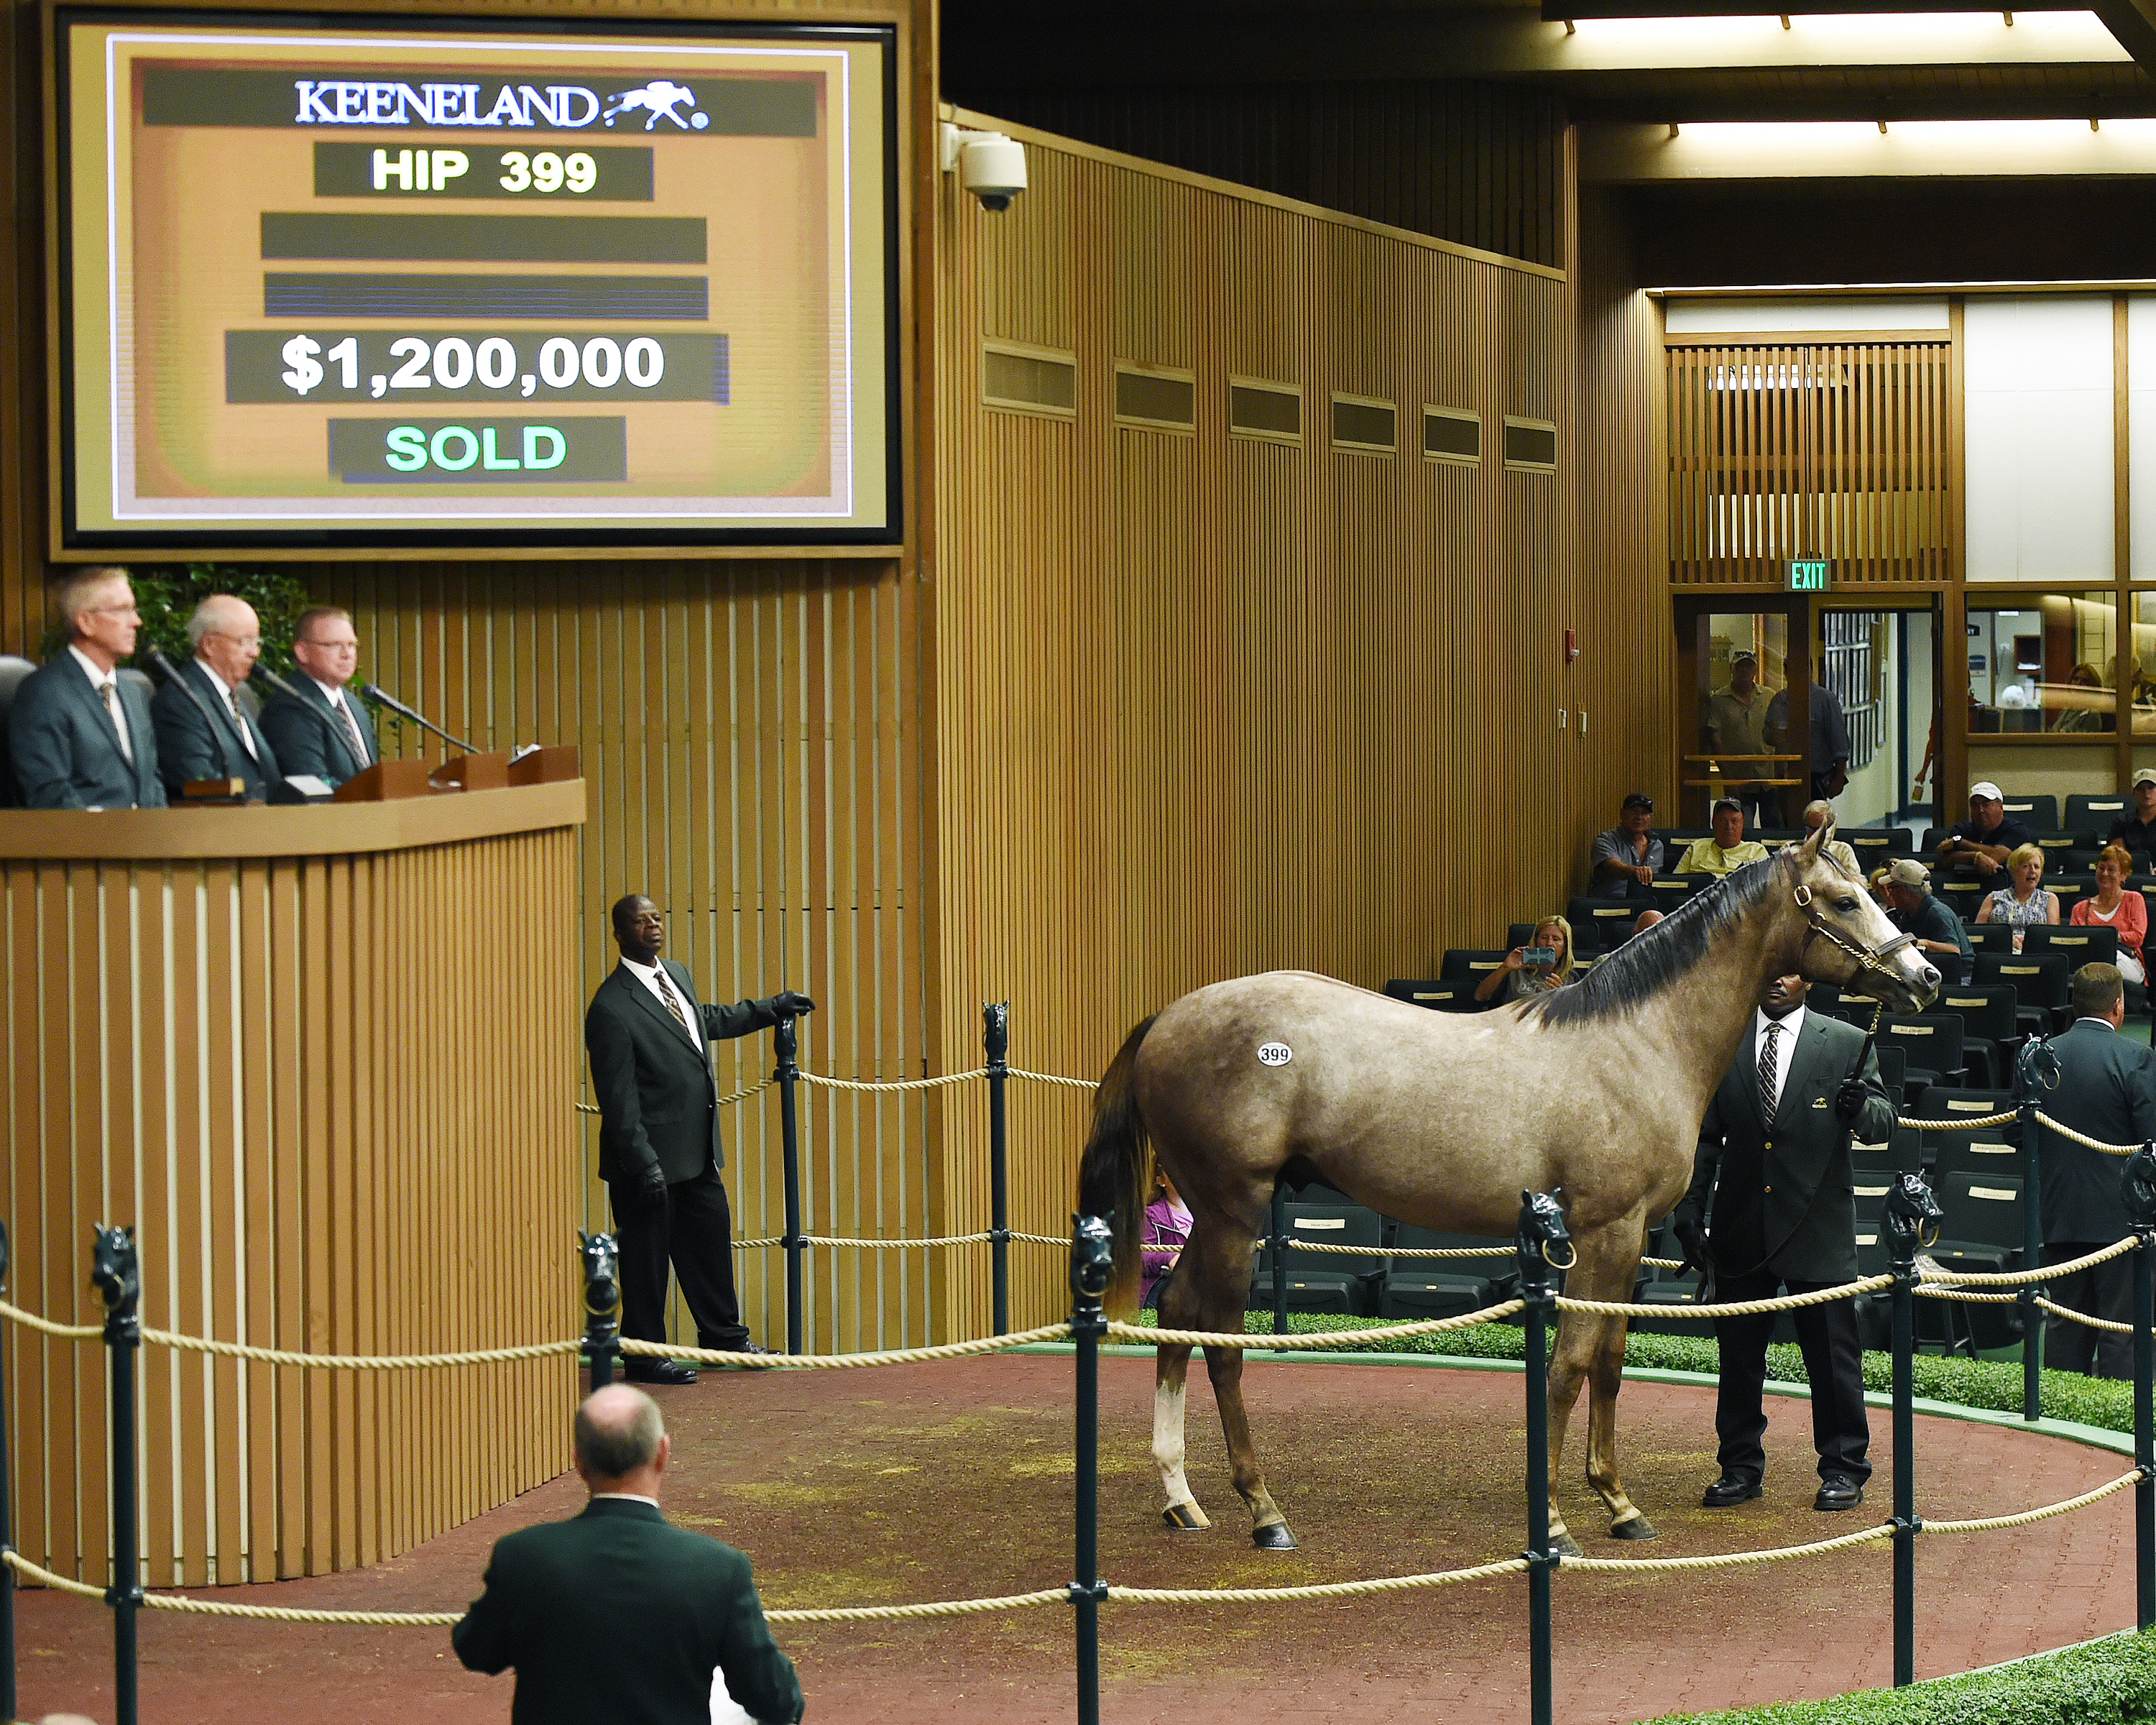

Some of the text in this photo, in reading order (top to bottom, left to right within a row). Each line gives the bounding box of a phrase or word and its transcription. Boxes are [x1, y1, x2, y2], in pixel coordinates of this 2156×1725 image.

[295, 80, 600, 127] KEENELAND
[372, 148, 598, 193] HIP 399
[281, 334, 665, 398] $1,200,000
[384, 425, 568, 472] SOLD
[1792, 562, 1826, 589] EXIT
[1261, 1048, 1289, 1061] 399
